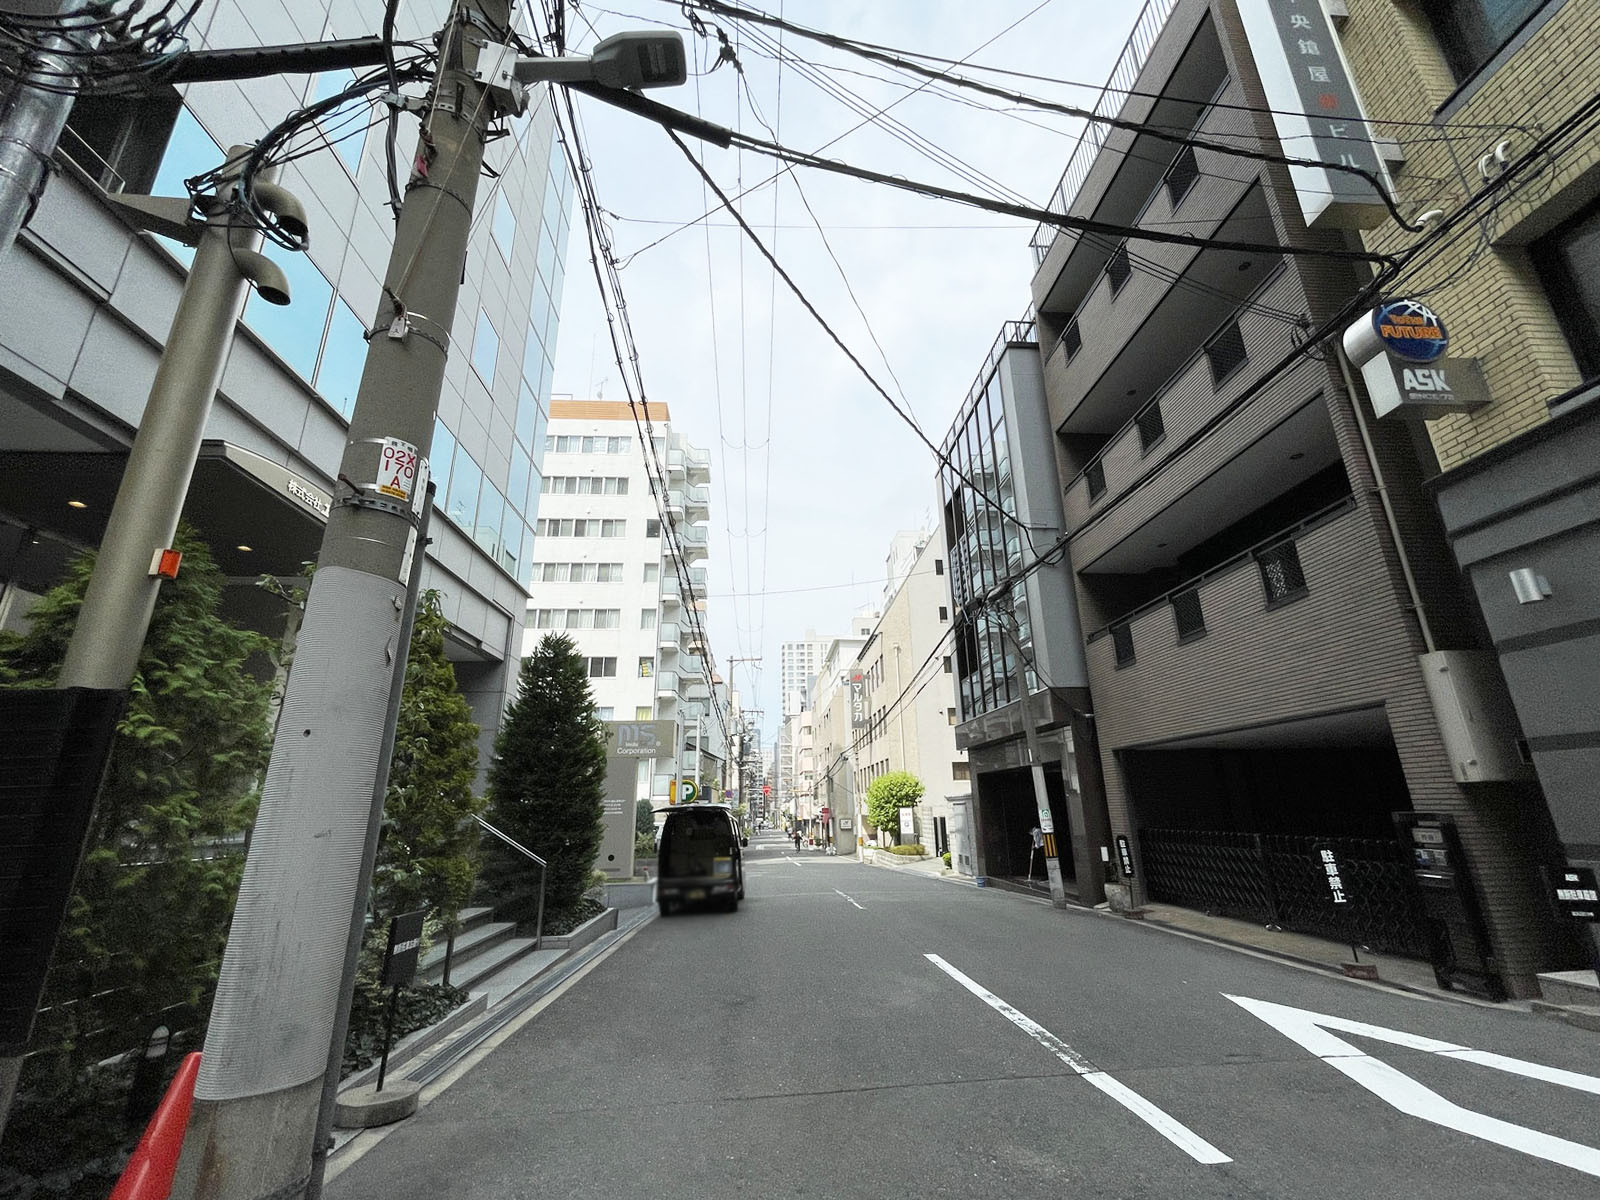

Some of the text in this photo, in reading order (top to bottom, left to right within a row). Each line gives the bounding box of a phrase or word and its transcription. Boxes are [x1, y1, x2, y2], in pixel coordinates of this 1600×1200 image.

[1380, 325, 1443, 339] FUTURE
[1403, 368, 1452, 391] ASK
[383, 447, 416, 468] 02X
[390, 475, 401, 489] A
[851, 682, 863, 722] マルタカ
[617, 747, 657, 755] Corporation
[681, 784, 694, 800] P
[1320, 849, 1347, 903] 駐車禁止
